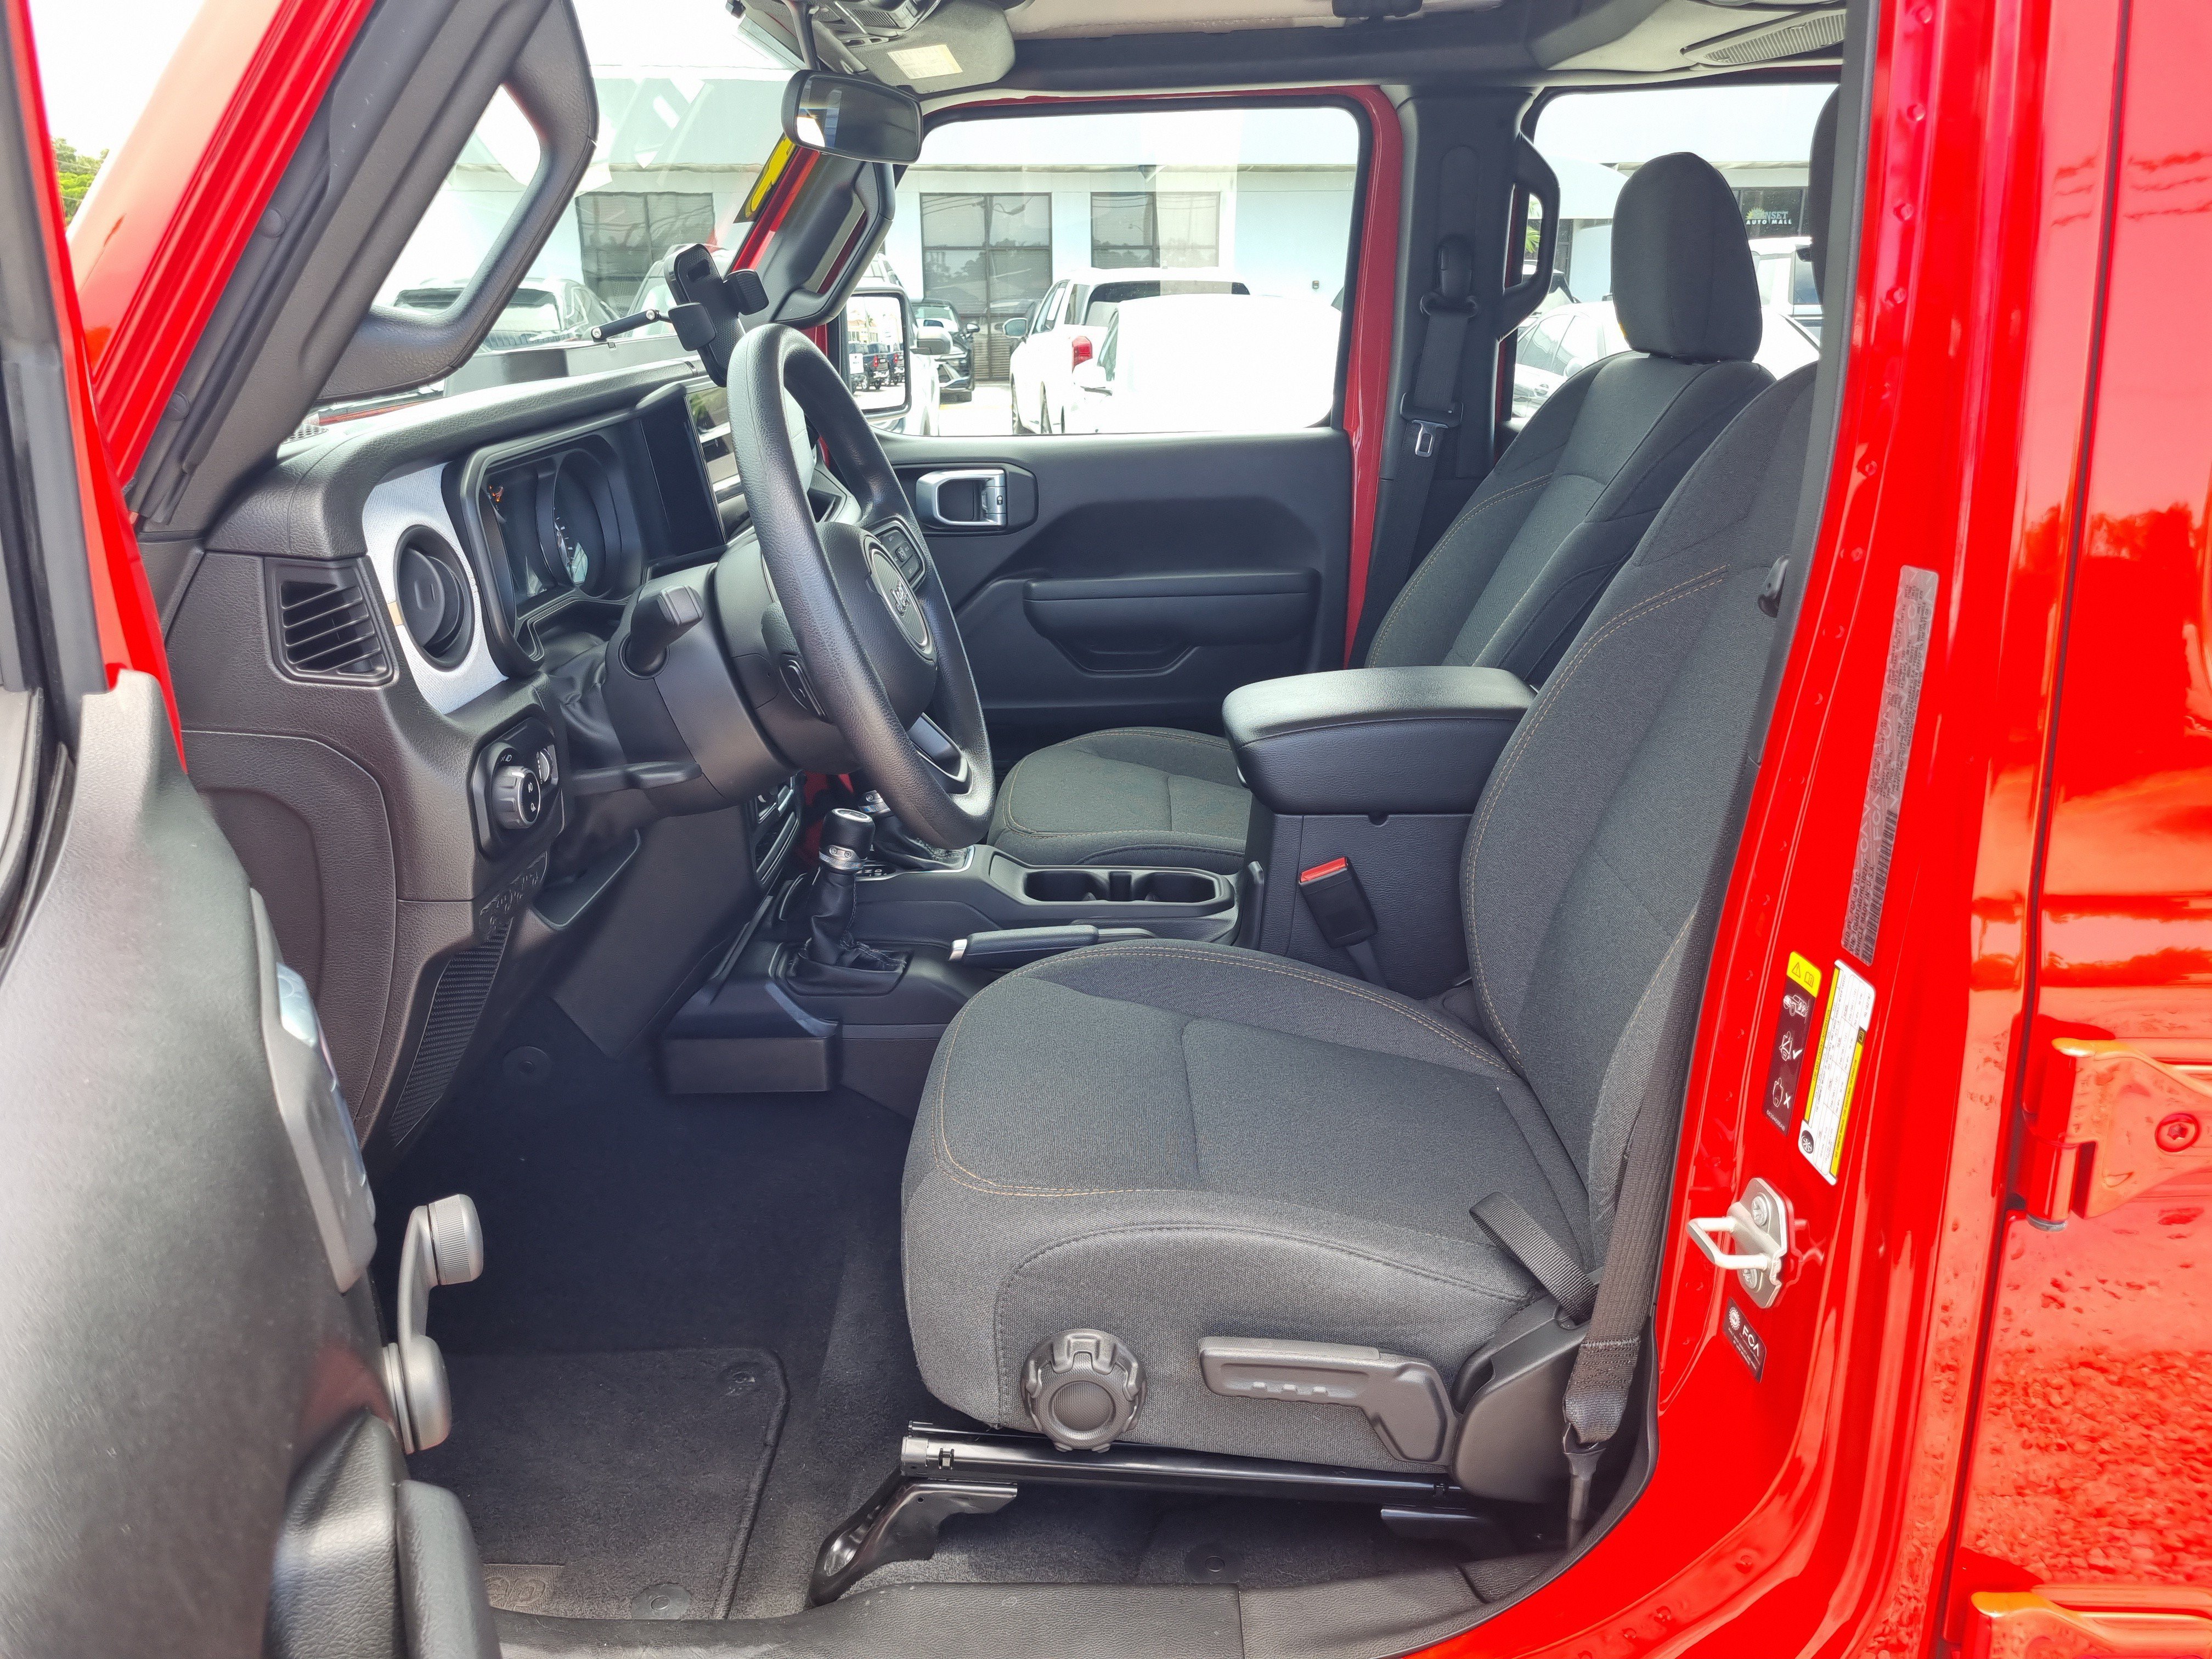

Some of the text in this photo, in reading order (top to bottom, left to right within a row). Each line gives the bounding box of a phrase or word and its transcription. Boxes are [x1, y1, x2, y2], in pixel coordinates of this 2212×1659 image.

[1752, 210, 1788, 224] NSET
[1852, 885, 1858, 899] US
[1854, 924, 1864, 957] VEHICLE
[1860, 900, 1868, 924] MADE
[1742, 1324, 1759, 1357] FCA
